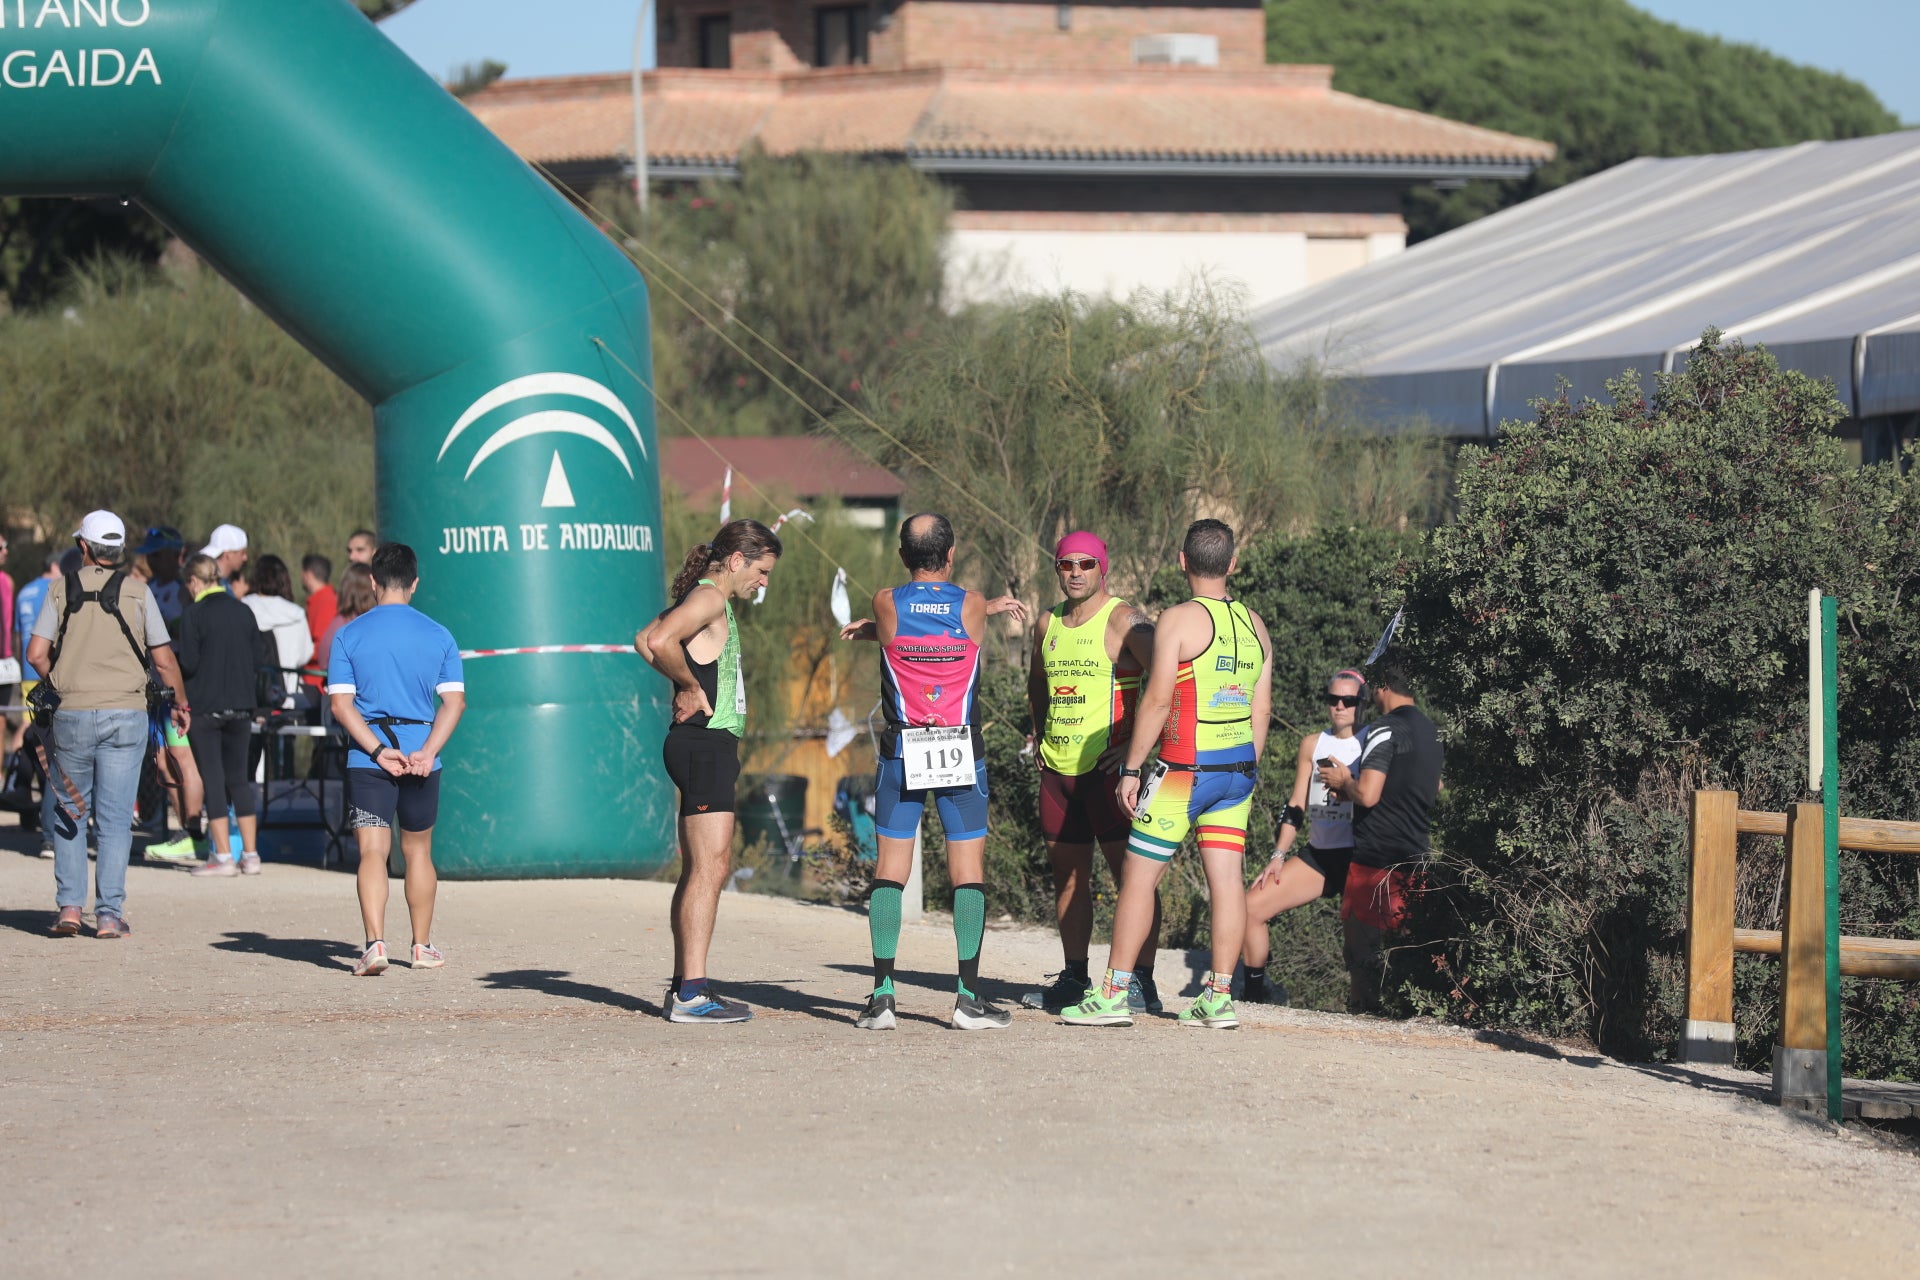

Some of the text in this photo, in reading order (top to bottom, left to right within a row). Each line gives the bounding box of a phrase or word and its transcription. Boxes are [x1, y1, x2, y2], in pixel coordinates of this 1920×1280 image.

[0, 47, 162, 89] GAIDA
[439, 523, 653, 555] JUNTA DE ANDALUCIA
[909, 603, 951, 615] TORRES
[896, 644, 967, 653] GADEIRAS SPORT
[1057, 657, 1099, 668] TRIATLÓN
[1220, 659, 1254, 670] Be first
[1047, 669, 1095, 678] UERTO REAL
[1052, 716, 1084, 726] nfisport
[923, 747, 963, 770] 119
